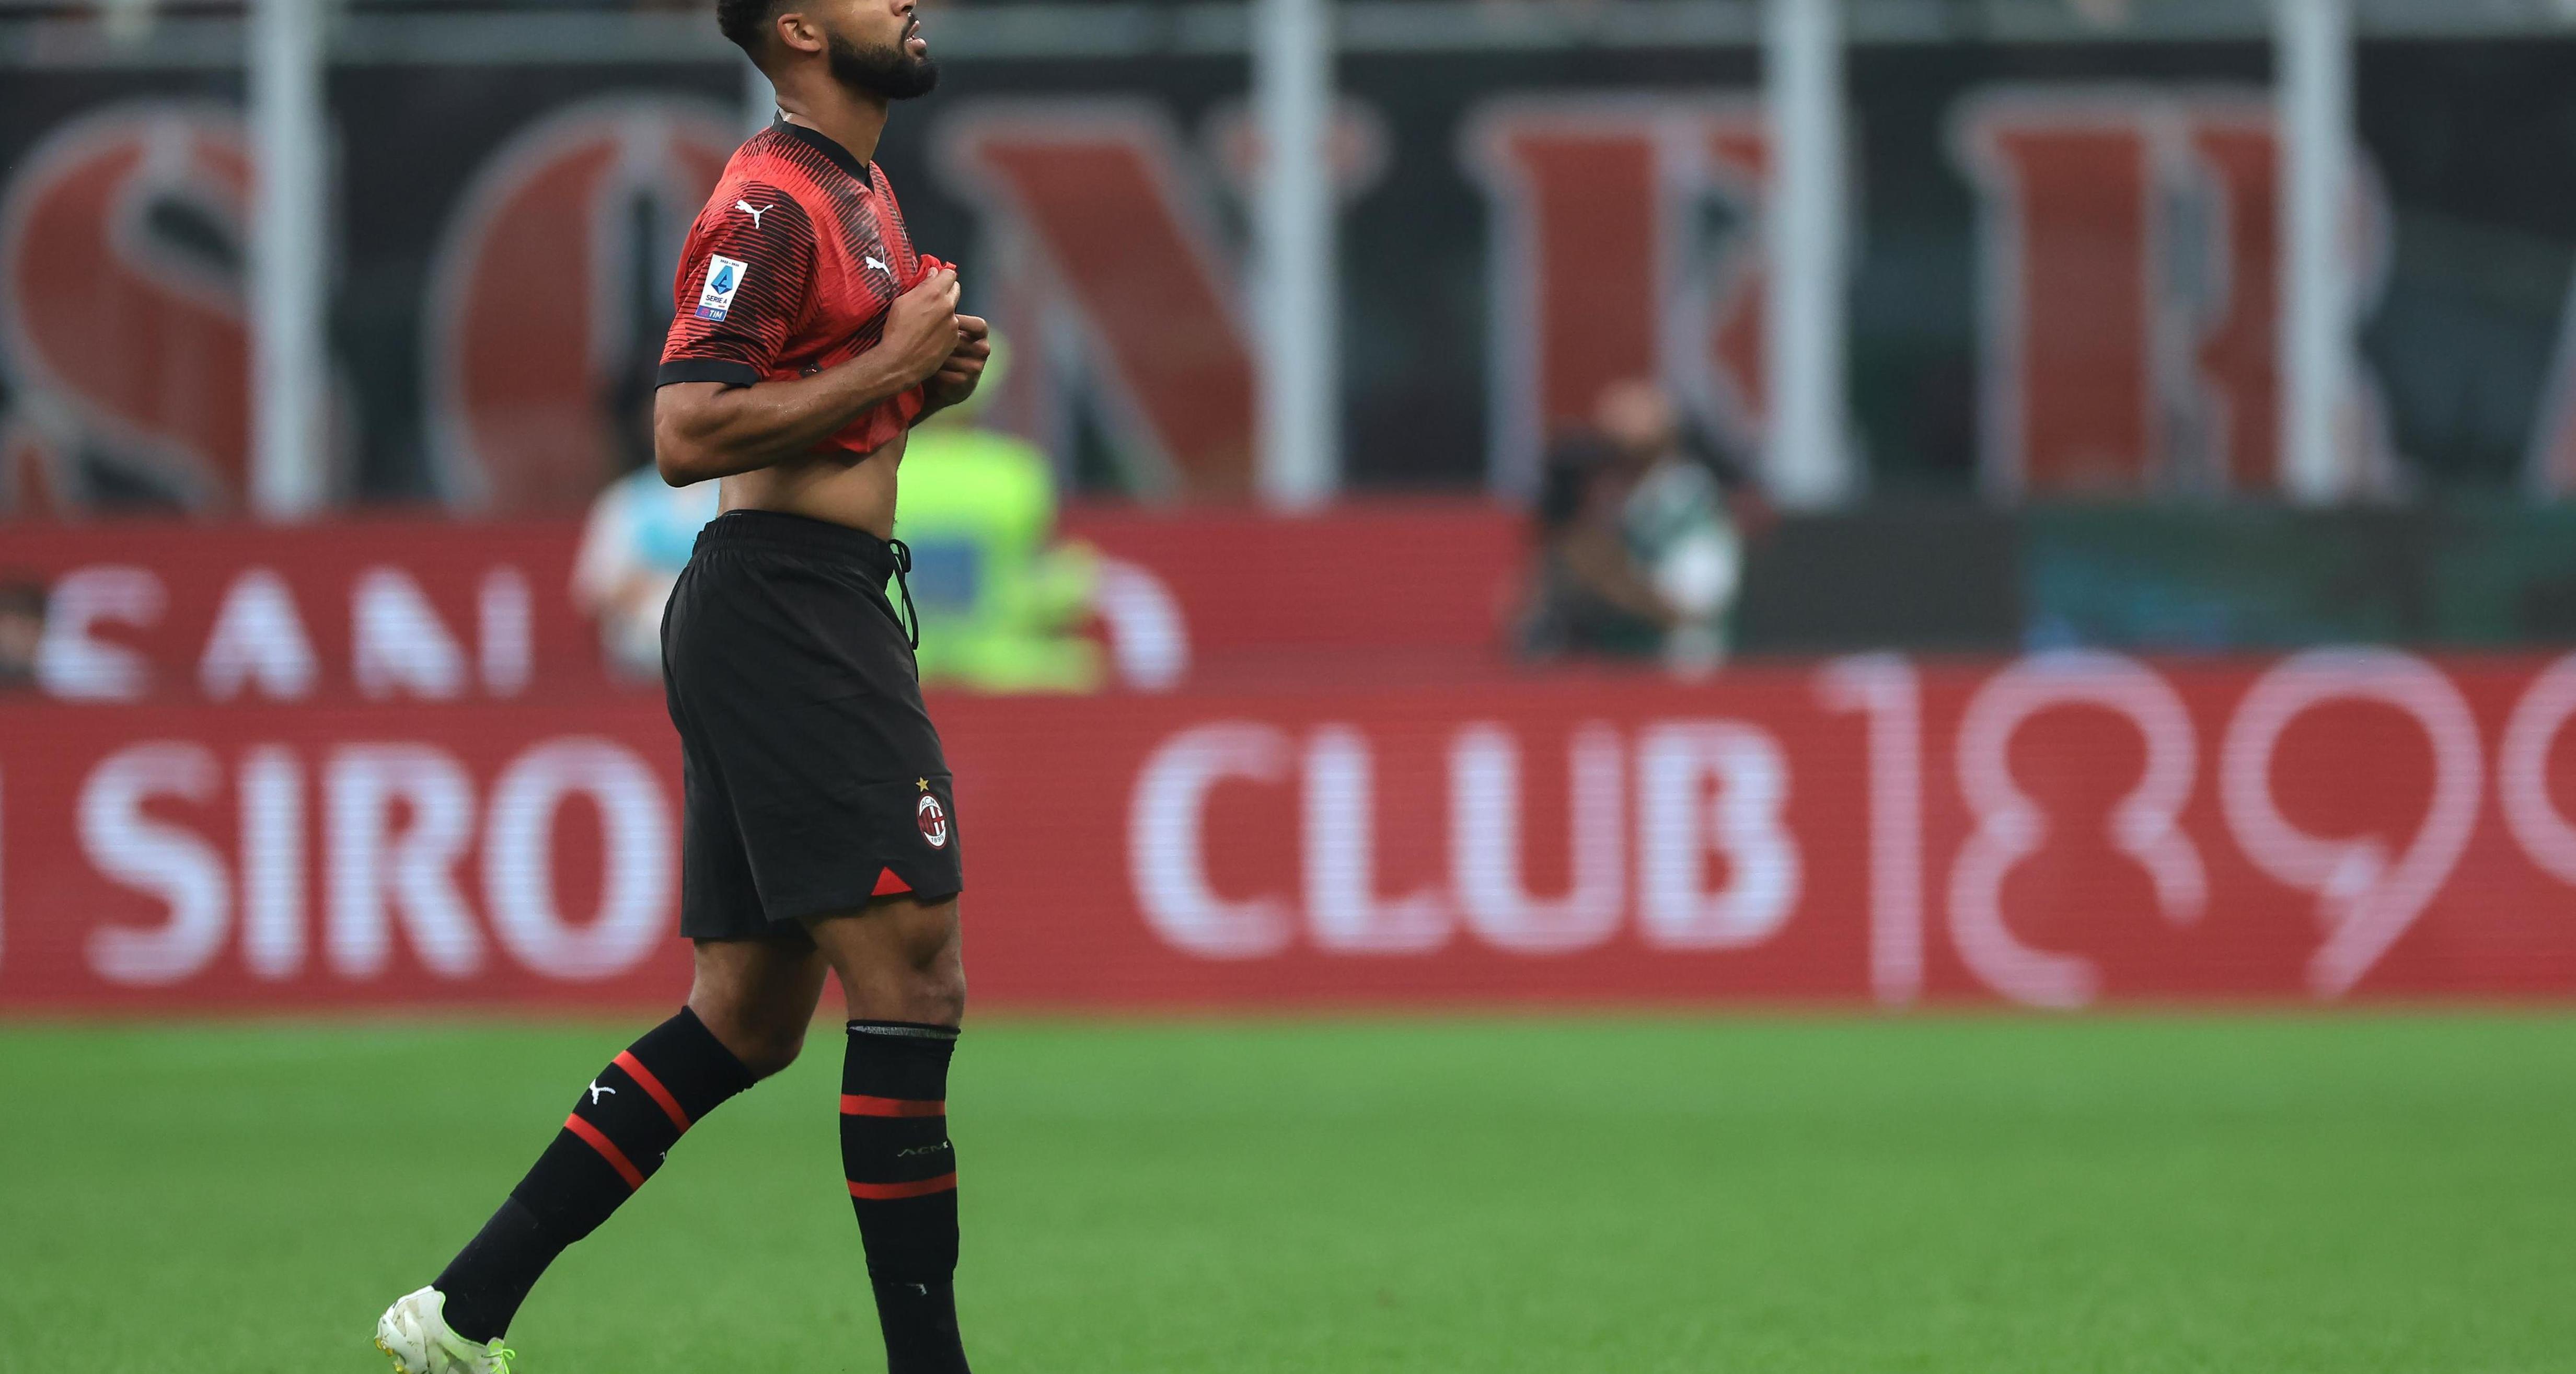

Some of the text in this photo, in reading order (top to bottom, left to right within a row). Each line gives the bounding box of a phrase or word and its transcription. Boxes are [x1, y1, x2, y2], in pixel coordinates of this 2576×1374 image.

[706, 295, 722, 303] SERIE
[709, 310, 723, 319] TIM
[921, 798, 937, 808] ACM
[930, 835, 944, 843] 1899
[1128, 719, 1802, 960] CLUB
[76, 736, 675, 985] SIRO
